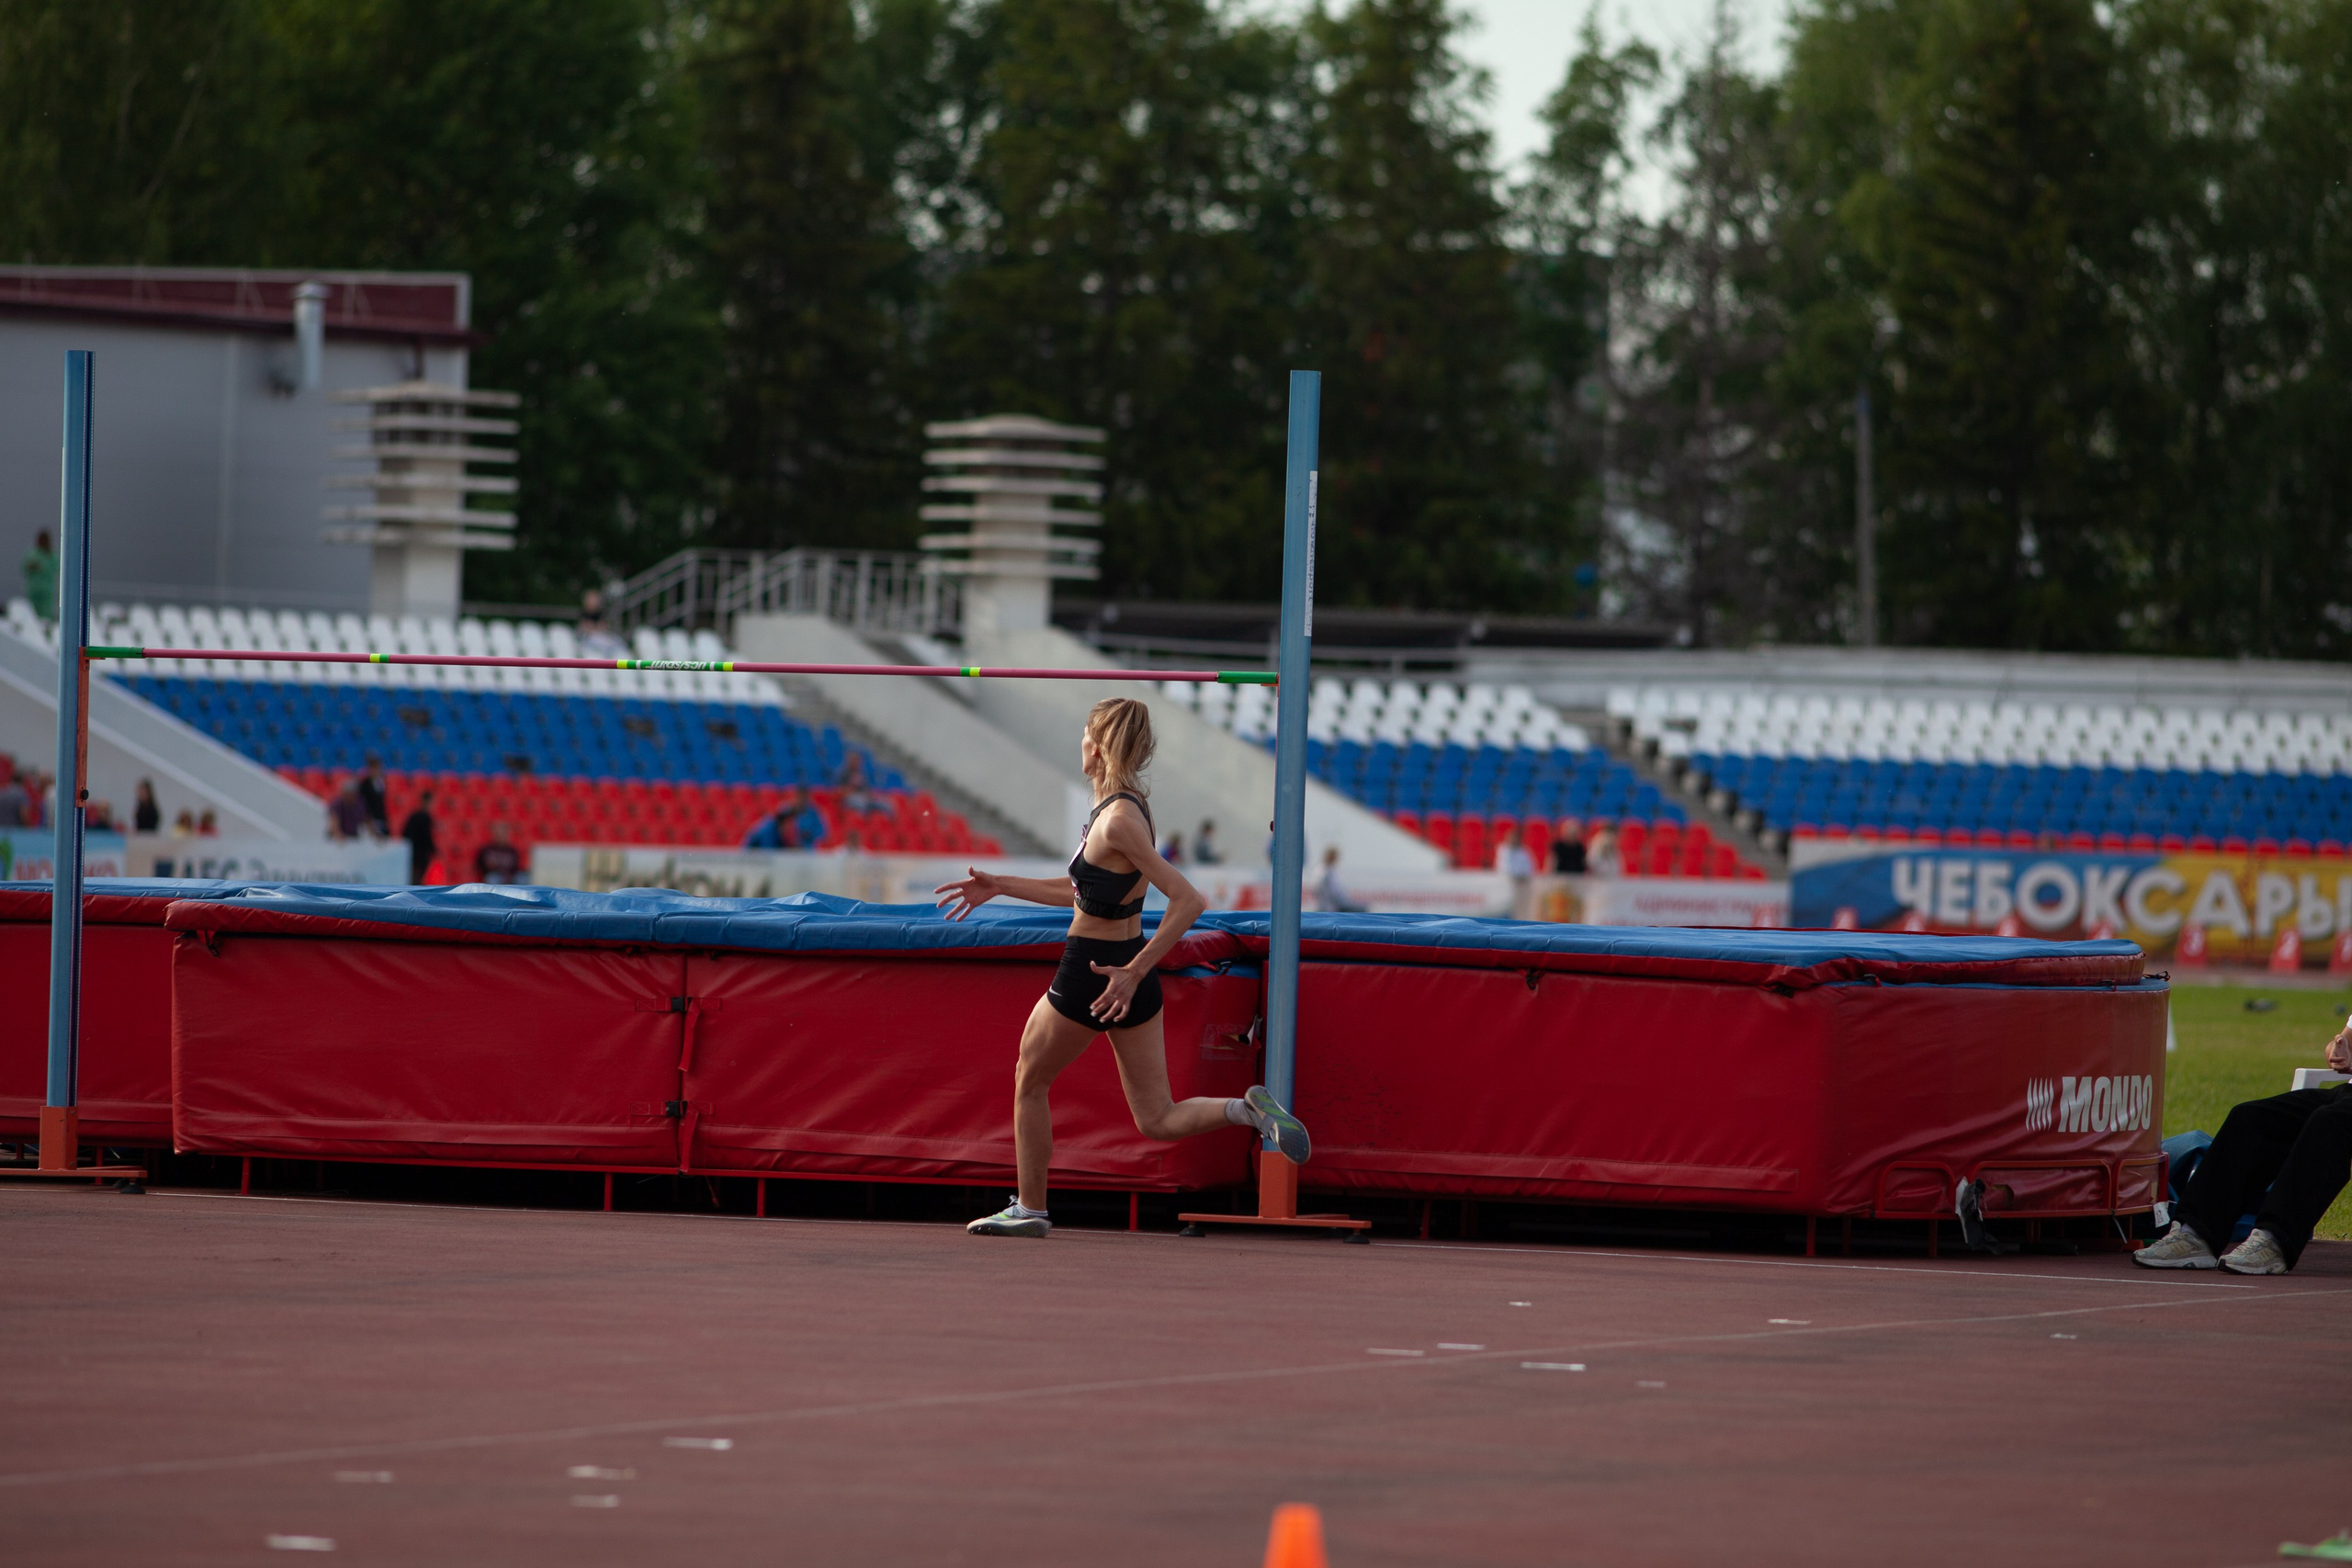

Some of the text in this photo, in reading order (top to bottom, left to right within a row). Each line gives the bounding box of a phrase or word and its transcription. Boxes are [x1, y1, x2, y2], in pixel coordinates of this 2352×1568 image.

[1891, 855, 2352, 940] ЧЕБОКСАРЫ
[2184, 928, 2204, 957] 3
[2058, 1075, 2153, 1132] MONDO
